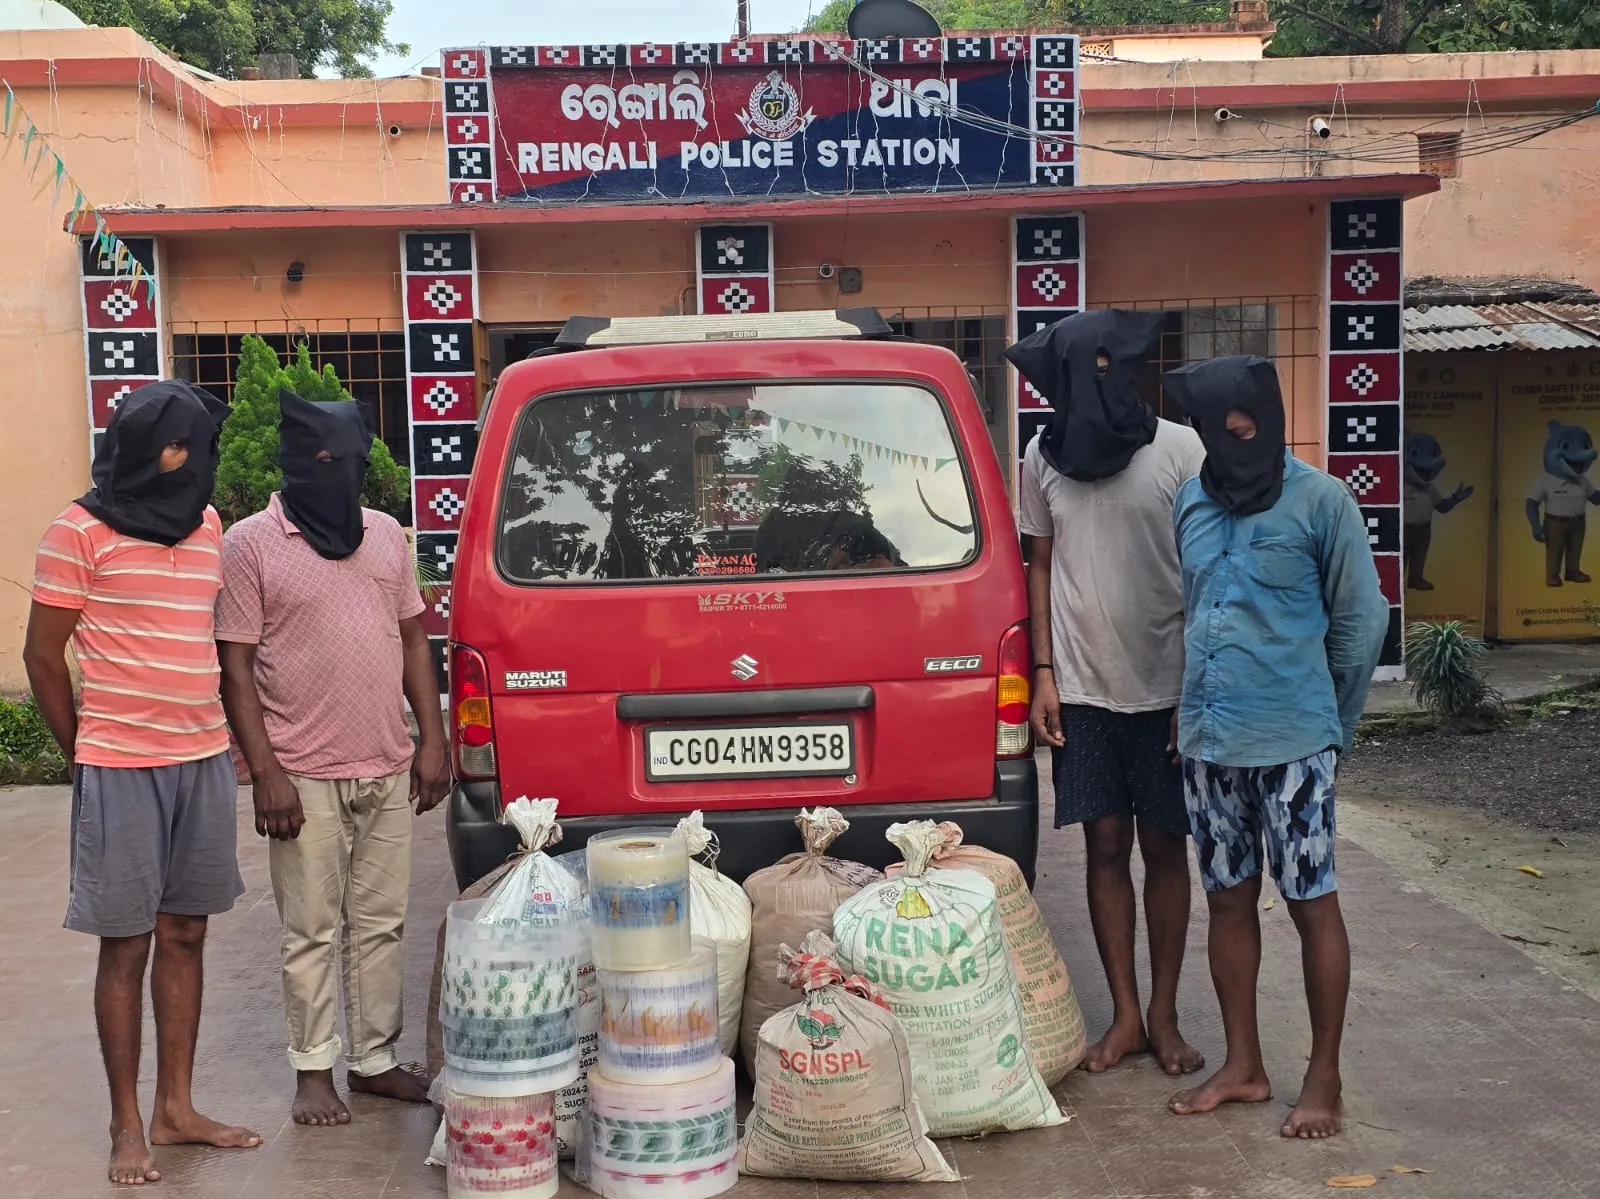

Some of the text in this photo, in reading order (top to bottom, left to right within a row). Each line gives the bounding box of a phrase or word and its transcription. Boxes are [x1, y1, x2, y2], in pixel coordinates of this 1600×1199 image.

[517, 138, 960, 174] RENGALI POLICE STATION
[741, 553, 757, 567] AC
[713, 592, 774, 606] SKY
[926, 658, 980, 671] EECO
[505, 671, 566, 680] MARUTI
[505, 679, 566, 688] SUZUKI
[653, 733, 844, 766] IND CG04HN9358
[866, 917, 973, 957] RENA
[864, 955, 979, 993] SUGAR
[1019, 979, 1045, 992] EIGHT
[924, 999, 972, 1018] WHITE
[972, 981, 1006, 1007] SUGAR
[779, 1049, 871, 1076] SGNSPL
[855, 1127, 881, 1143] PRIVATE
